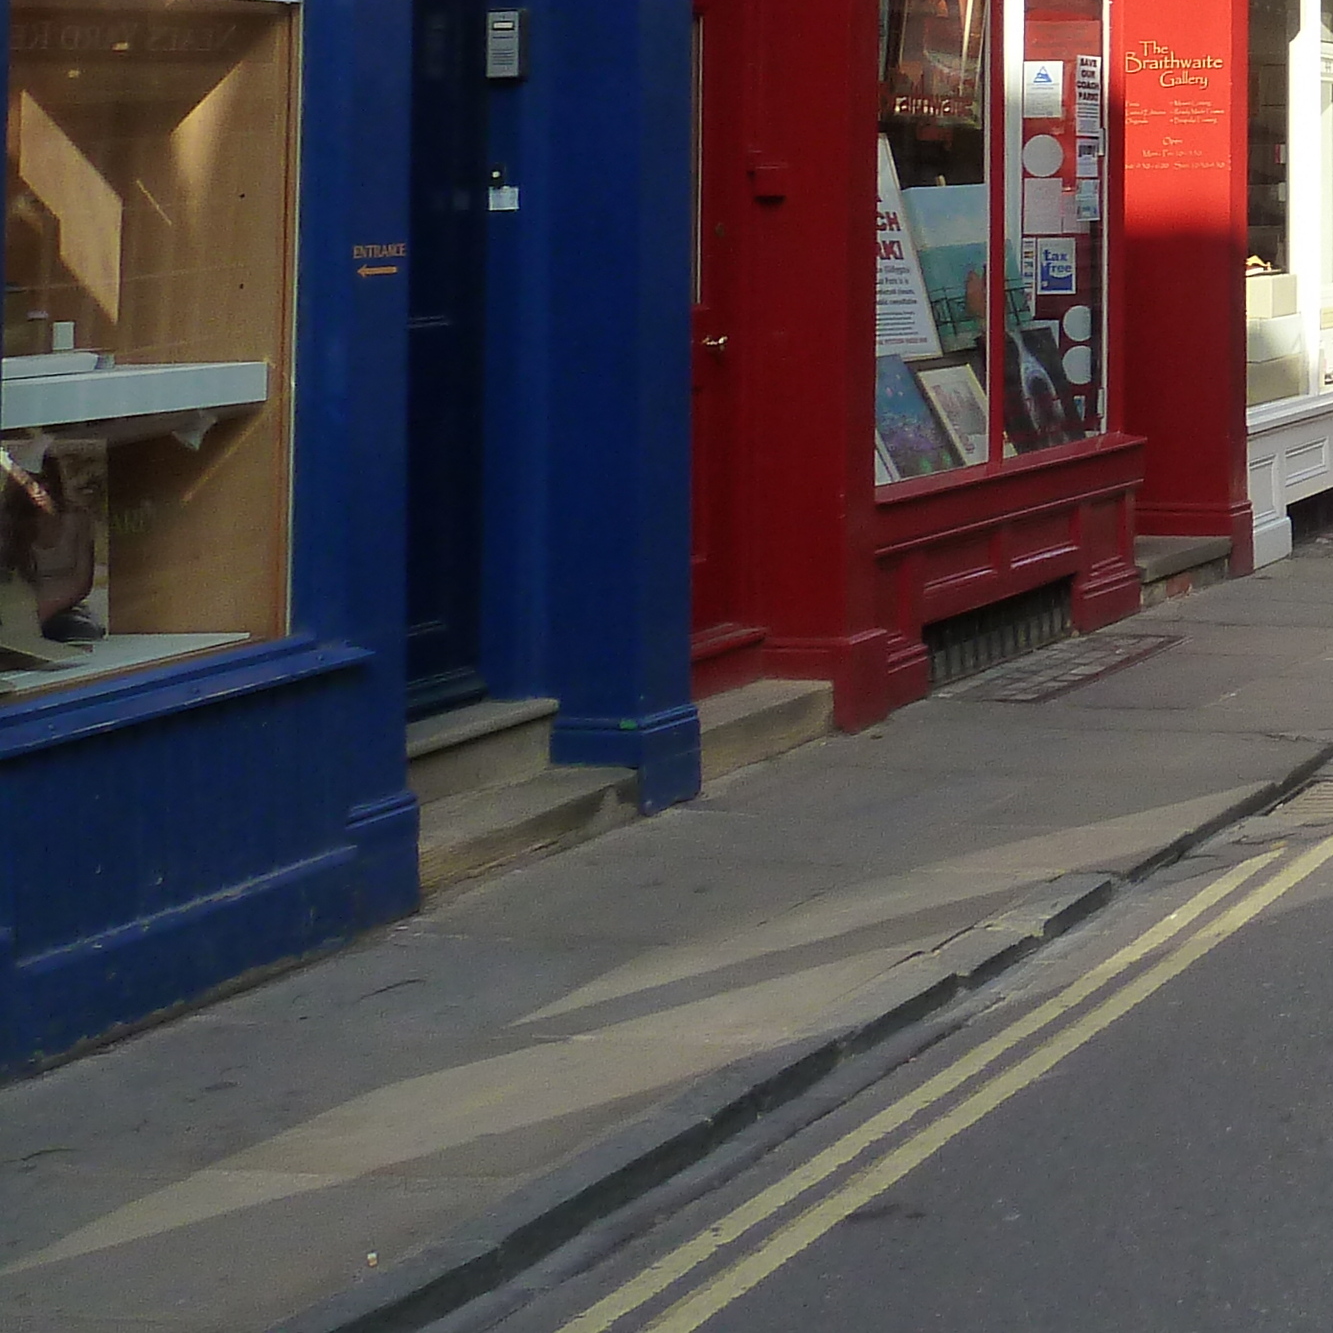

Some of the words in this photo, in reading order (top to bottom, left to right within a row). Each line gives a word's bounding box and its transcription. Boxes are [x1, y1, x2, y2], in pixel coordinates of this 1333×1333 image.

[1138, 40, 1168, 56] The
[1124, 51, 1223, 73] Braithwaite
[1159, 70, 1208, 90] Gallery
[353, 243, 407, 260] ENTRANCE
[1043, 249, 1068, 262] tax
[1041, 262, 1073, 273] free
